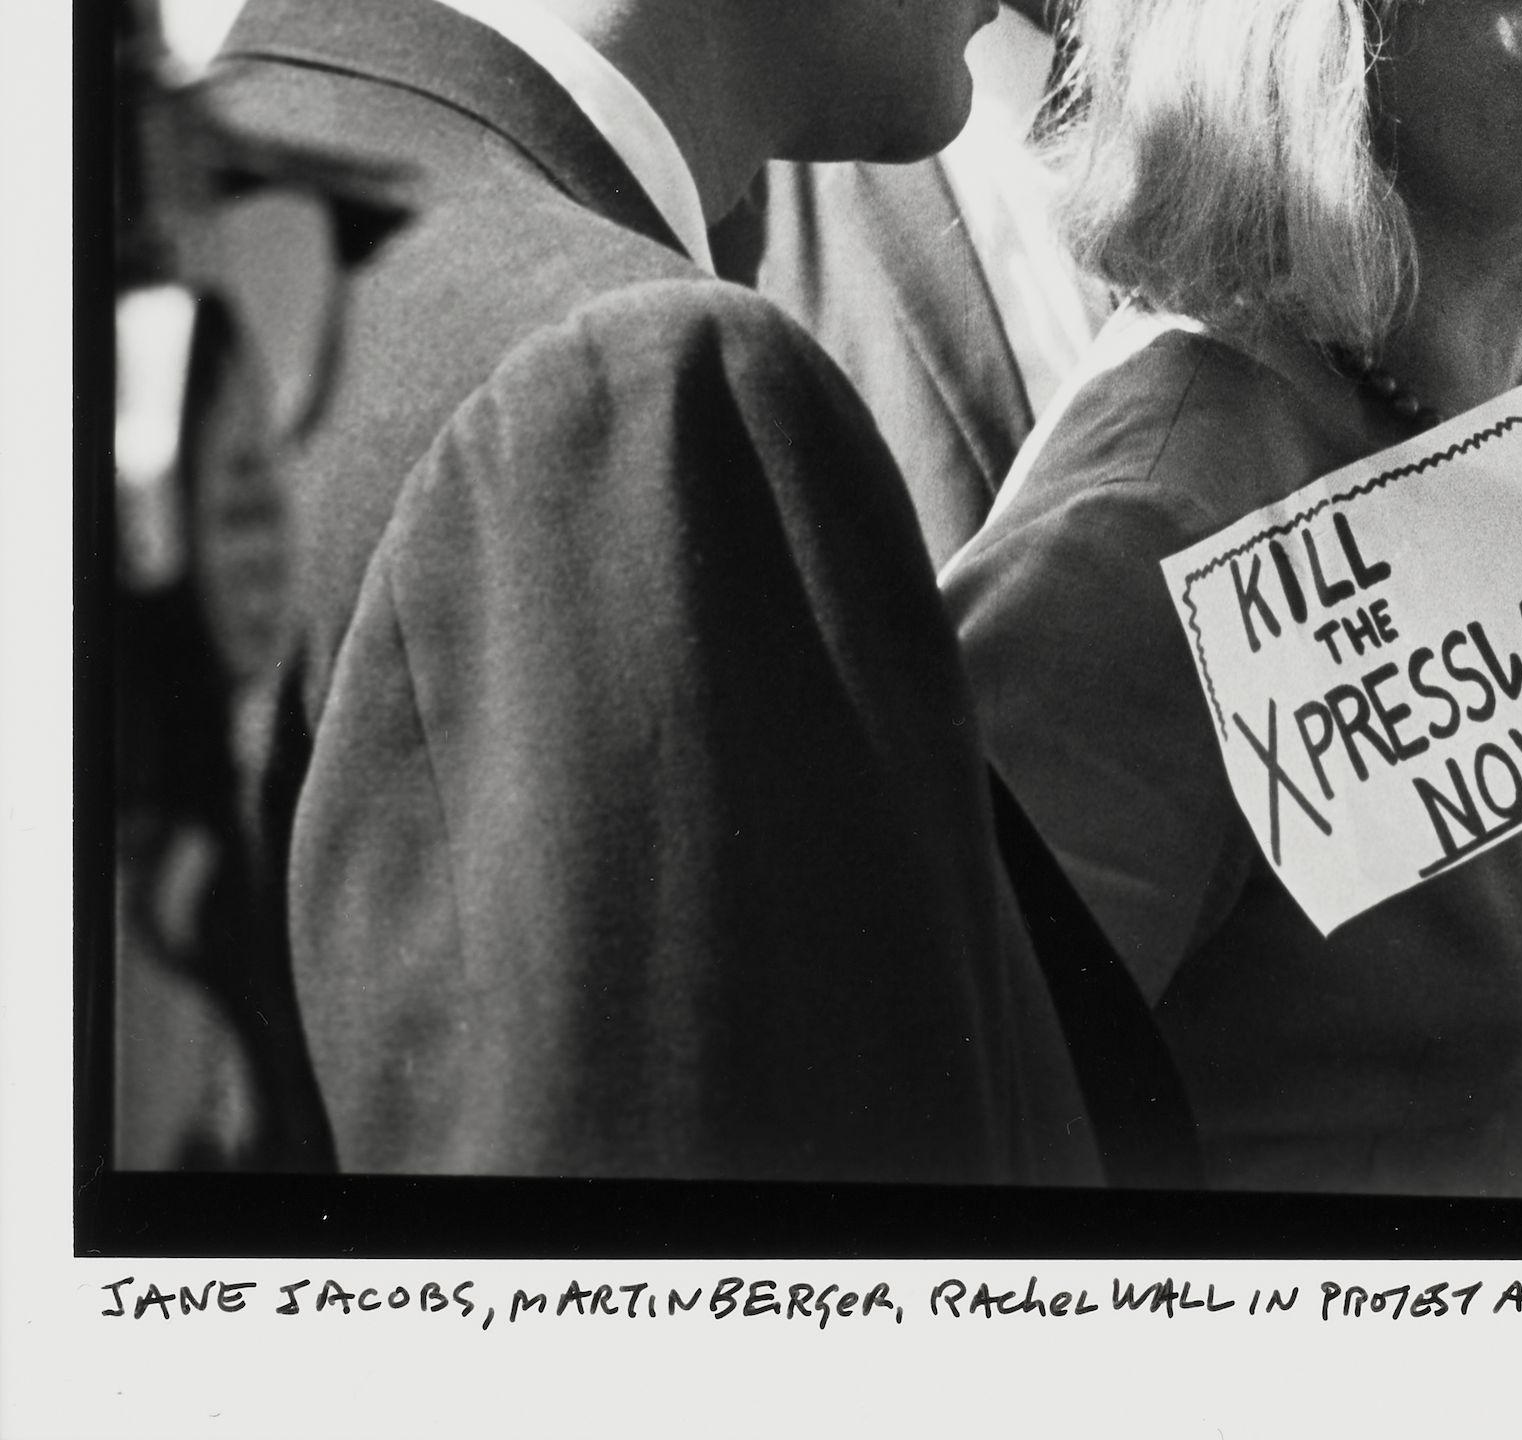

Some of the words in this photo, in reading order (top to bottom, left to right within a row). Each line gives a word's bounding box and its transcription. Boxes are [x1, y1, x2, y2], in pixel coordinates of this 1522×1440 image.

[1231, 511, 1391, 653] KILL
[1314, 598, 1399, 664] THE
[101, 1277, 257, 1319] JANE
[276, 1279, 494, 1330] JACOBS,
[1113, 1278, 1235, 1318] WALL
[1249, 1287, 1298, 1315] IN
[1321, 1281, 1482, 1321] PROTEST
